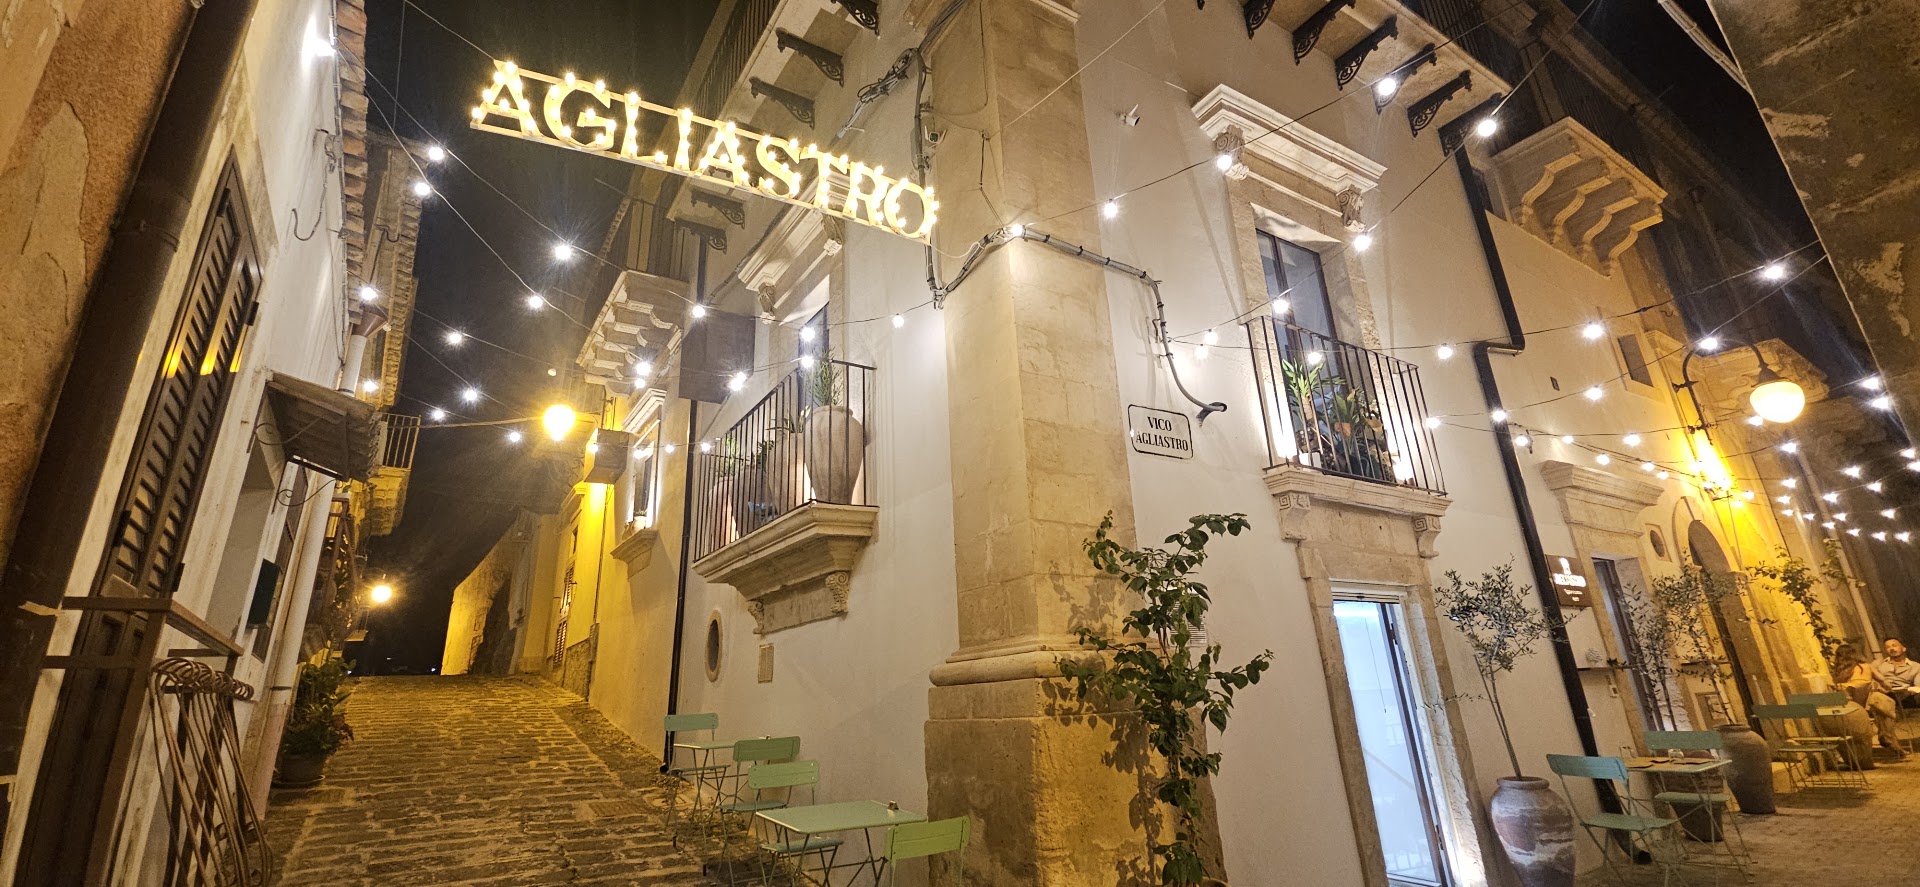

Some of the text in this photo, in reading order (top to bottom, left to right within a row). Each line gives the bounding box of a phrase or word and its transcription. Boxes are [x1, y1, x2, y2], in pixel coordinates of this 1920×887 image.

[472, 62, 940, 240] AGLIASTRO
[1147, 416, 1172, 431] VICO
[1136, 432, 1189, 451] AGLIASTRO
